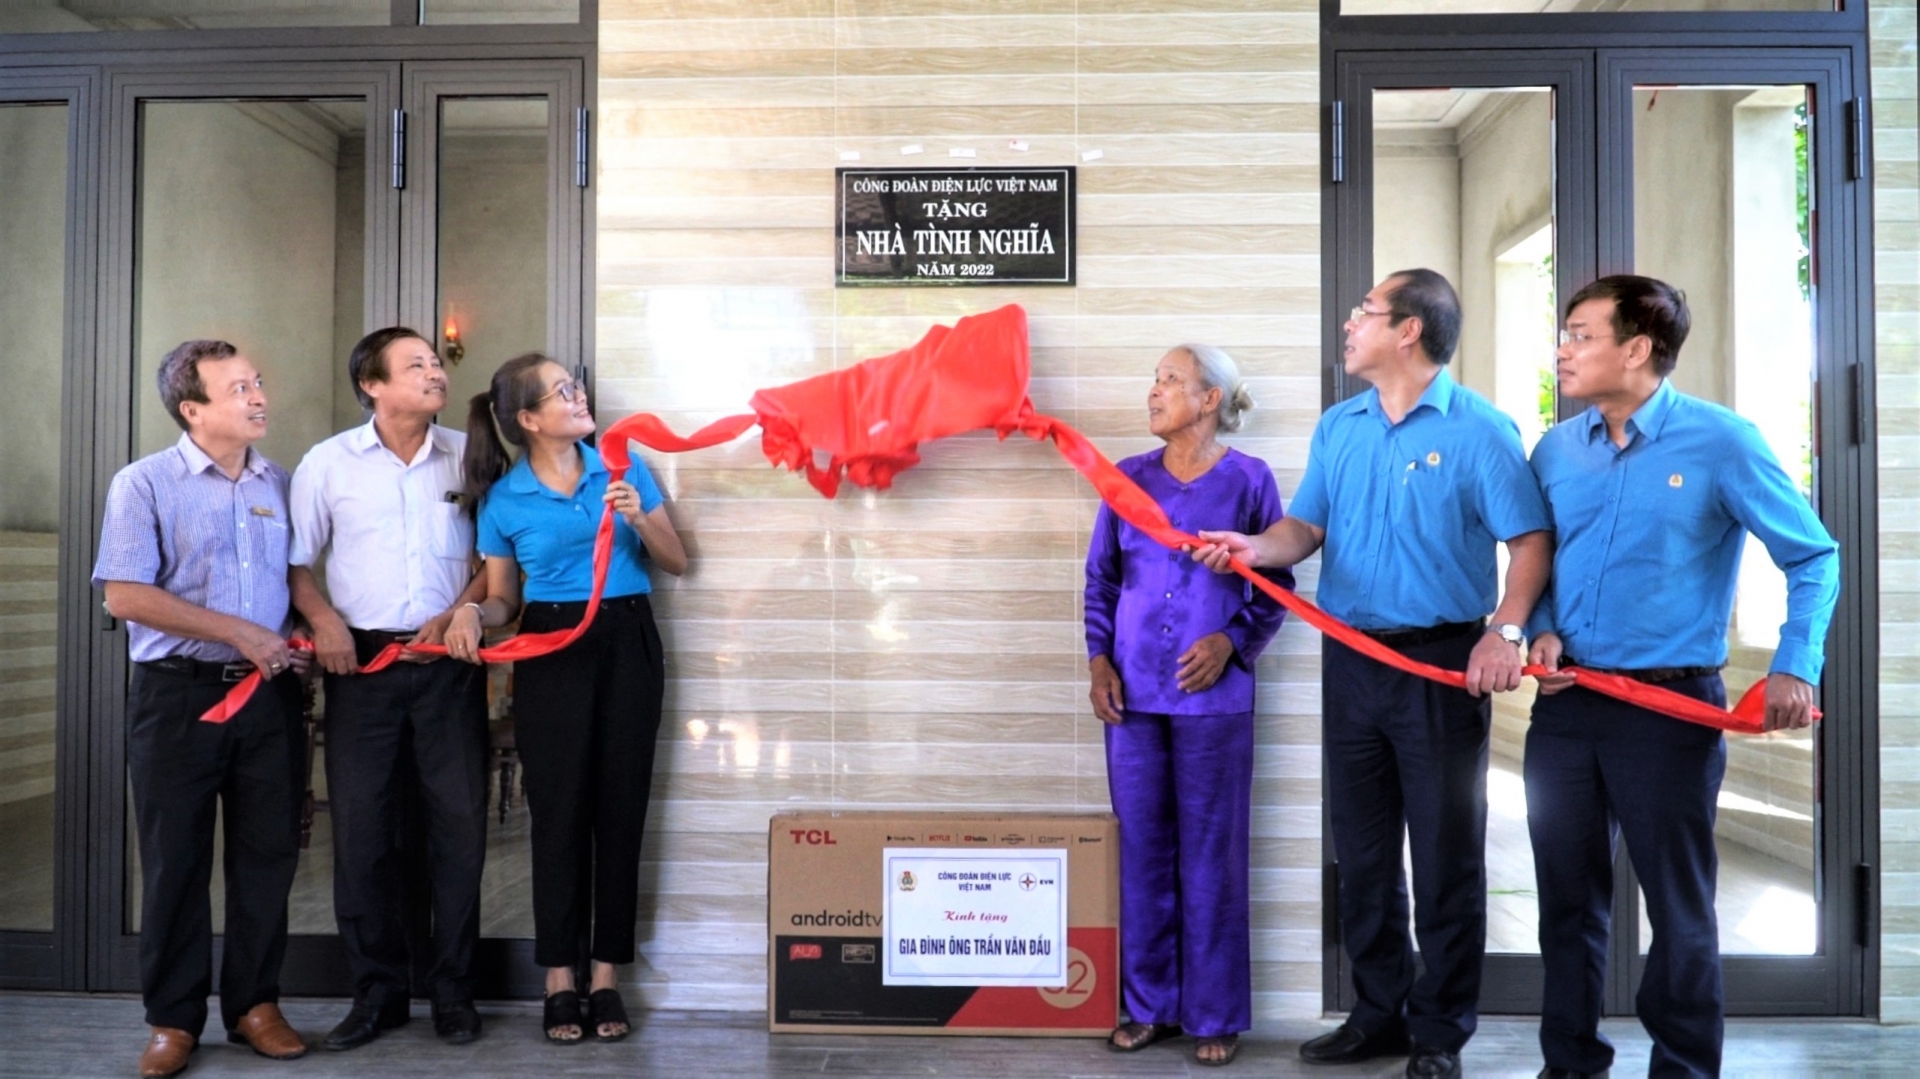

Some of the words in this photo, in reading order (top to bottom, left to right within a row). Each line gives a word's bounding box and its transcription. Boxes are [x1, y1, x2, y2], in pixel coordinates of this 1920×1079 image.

[853, 178, 890, 193] CÔNG
[892, 177, 929, 193] ĐOÀN
[931, 176, 963, 195] ĐIỆN
[966, 178, 993, 195] LỰC
[995, 176, 1027, 195] VIỆT
[1029, 179, 1058, 192] NAM
[922, 199, 988, 221] TẶNG
[856, 222, 907, 255] NHÀ
[913, 222, 972, 255] TÌNH
[978, 222, 1055, 255] NGHĨA
[916, 263, 955, 276] NĂM
[960, 264, 995, 276] 2022
[790, 829, 837, 845] TCL
[937, 872, 957, 881] CÔNG
[958, 883, 973, 892] VIỆT
[899, 938, 917, 955] GIA
[920, 935, 946, 955] ĐÌNH
[949, 935, 971, 955] ÔNG
[1005, 935, 1026, 956] VĂN
